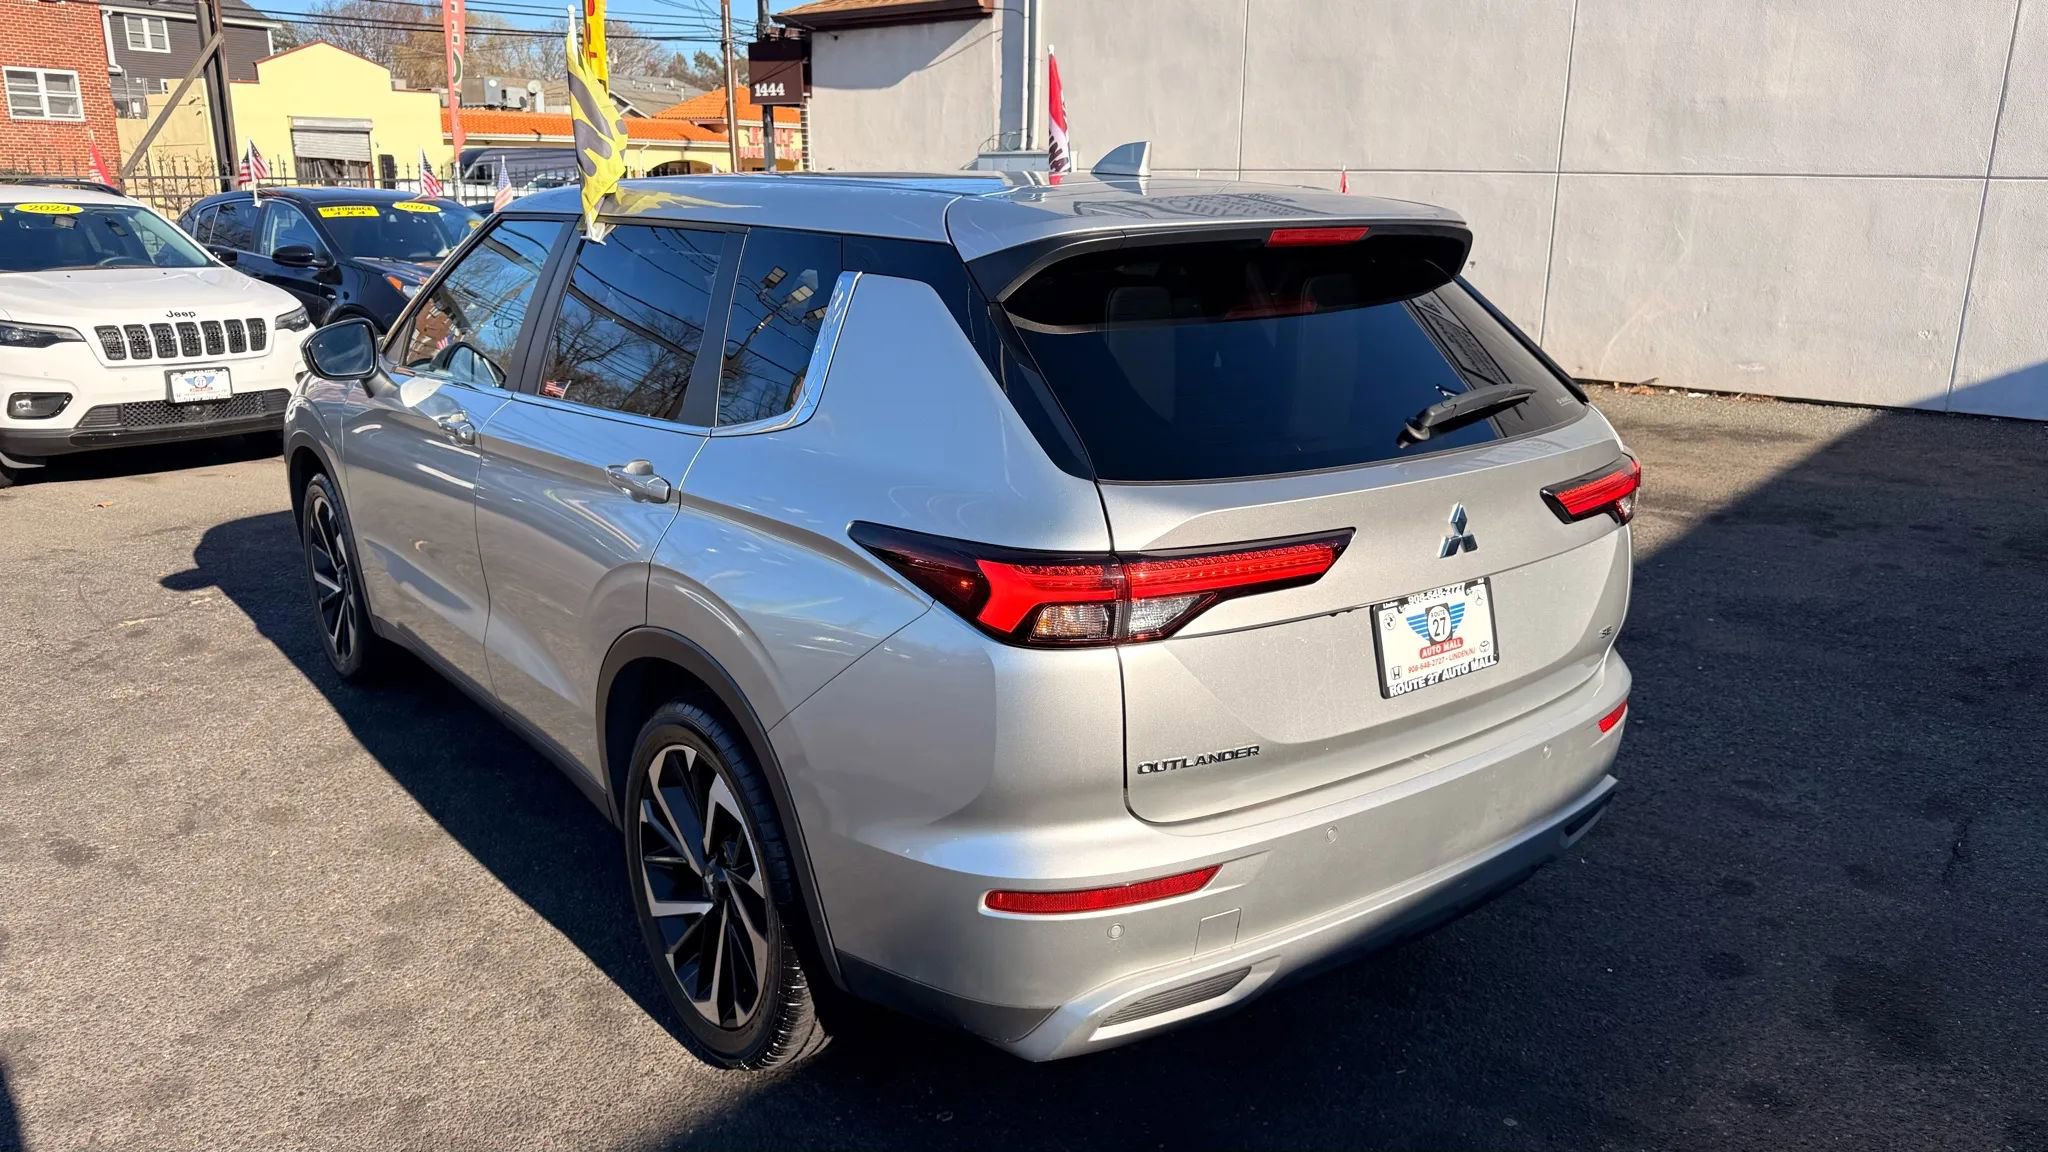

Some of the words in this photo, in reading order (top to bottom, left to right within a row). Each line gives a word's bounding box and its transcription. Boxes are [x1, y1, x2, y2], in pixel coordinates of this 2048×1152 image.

[754, 83, 785, 97] 1444
[165, 310, 196, 319] Jeep
[1430, 609, 1446, 619] ROUTE
[1432, 617, 1447, 637] 27
[1421, 644, 1442, 658] AUTO
[1443, 638, 1462, 652] MALL
[1389, 678, 1426, 697] ROUTE
[1427, 671, 1440, 686] 27
[1441, 663, 1470, 681] AUTO
[1470, 655, 1497, 673] MALL
[1136, 744, 1260, 775] OUTLANDER
